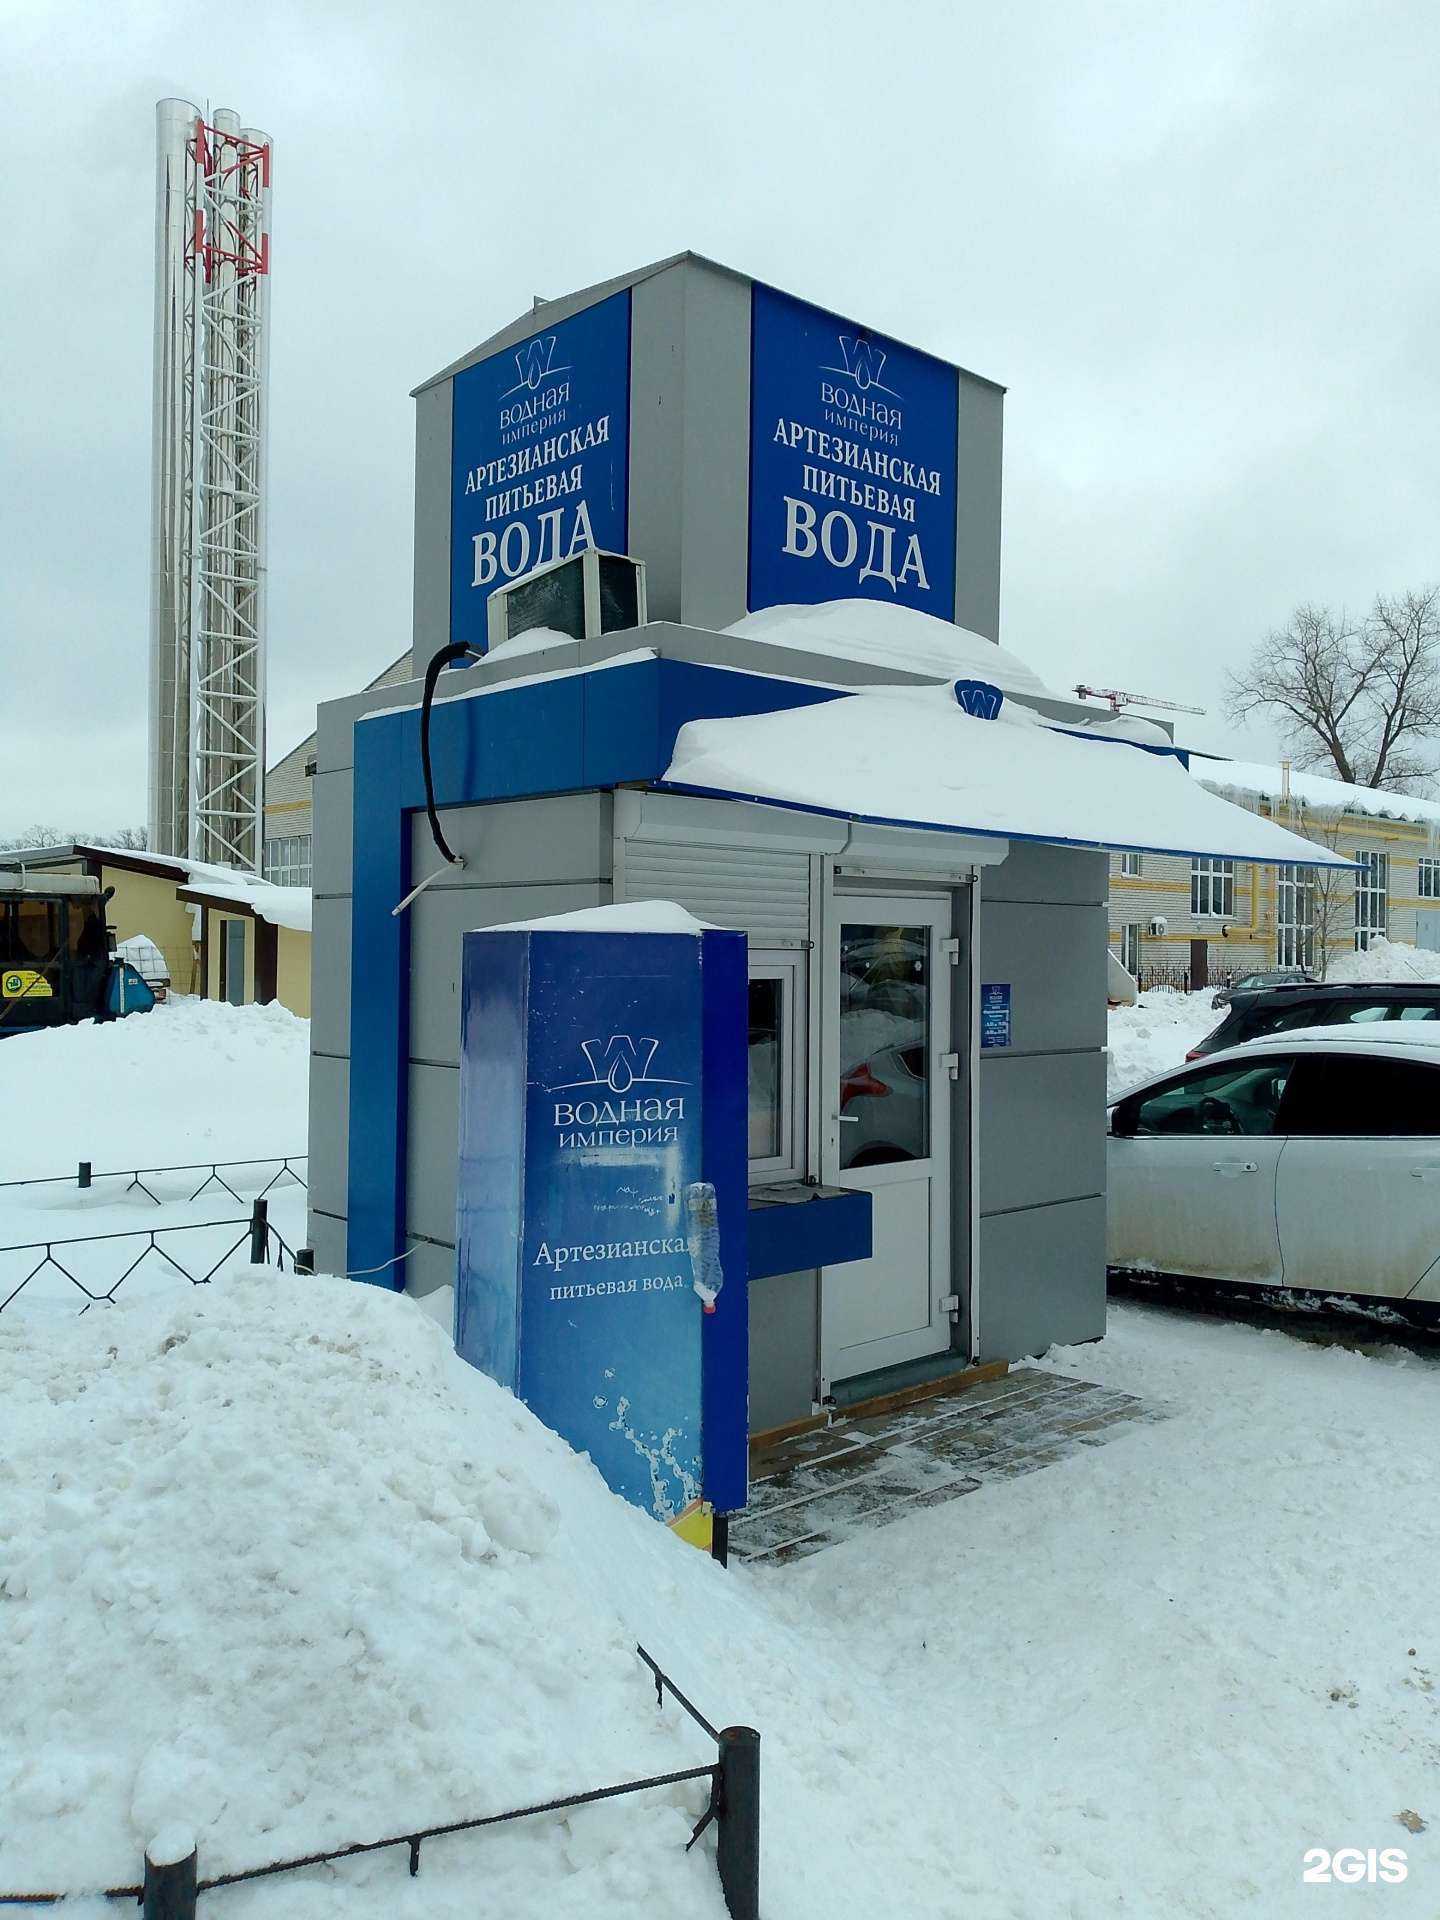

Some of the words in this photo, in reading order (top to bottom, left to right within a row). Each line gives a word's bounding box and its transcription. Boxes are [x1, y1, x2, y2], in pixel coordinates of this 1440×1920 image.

[465, 415, 610, 495] АРТЕЗИАНСКАЯ
[502, 408, 566, 445] империя
[825, 409, 899, 447] империя
[773, 418, 941, 496] АРТЕЗИАНСКАЯ
[485, 464, 583, 522] ПИТЬЕВАЯ
[802, 464, 915, 523] ПИТЬЕВАЯ
[471, 499, 598, 587] ВОДА
[782, 496, 930, 593] ВОДА
[559, 1126, 678, 1149] империя
[533, 1235, 691, 1272] Артезианска
[550, 1279, 637, 1301] питьевая
[643, 1274, 684, 1293] вода
